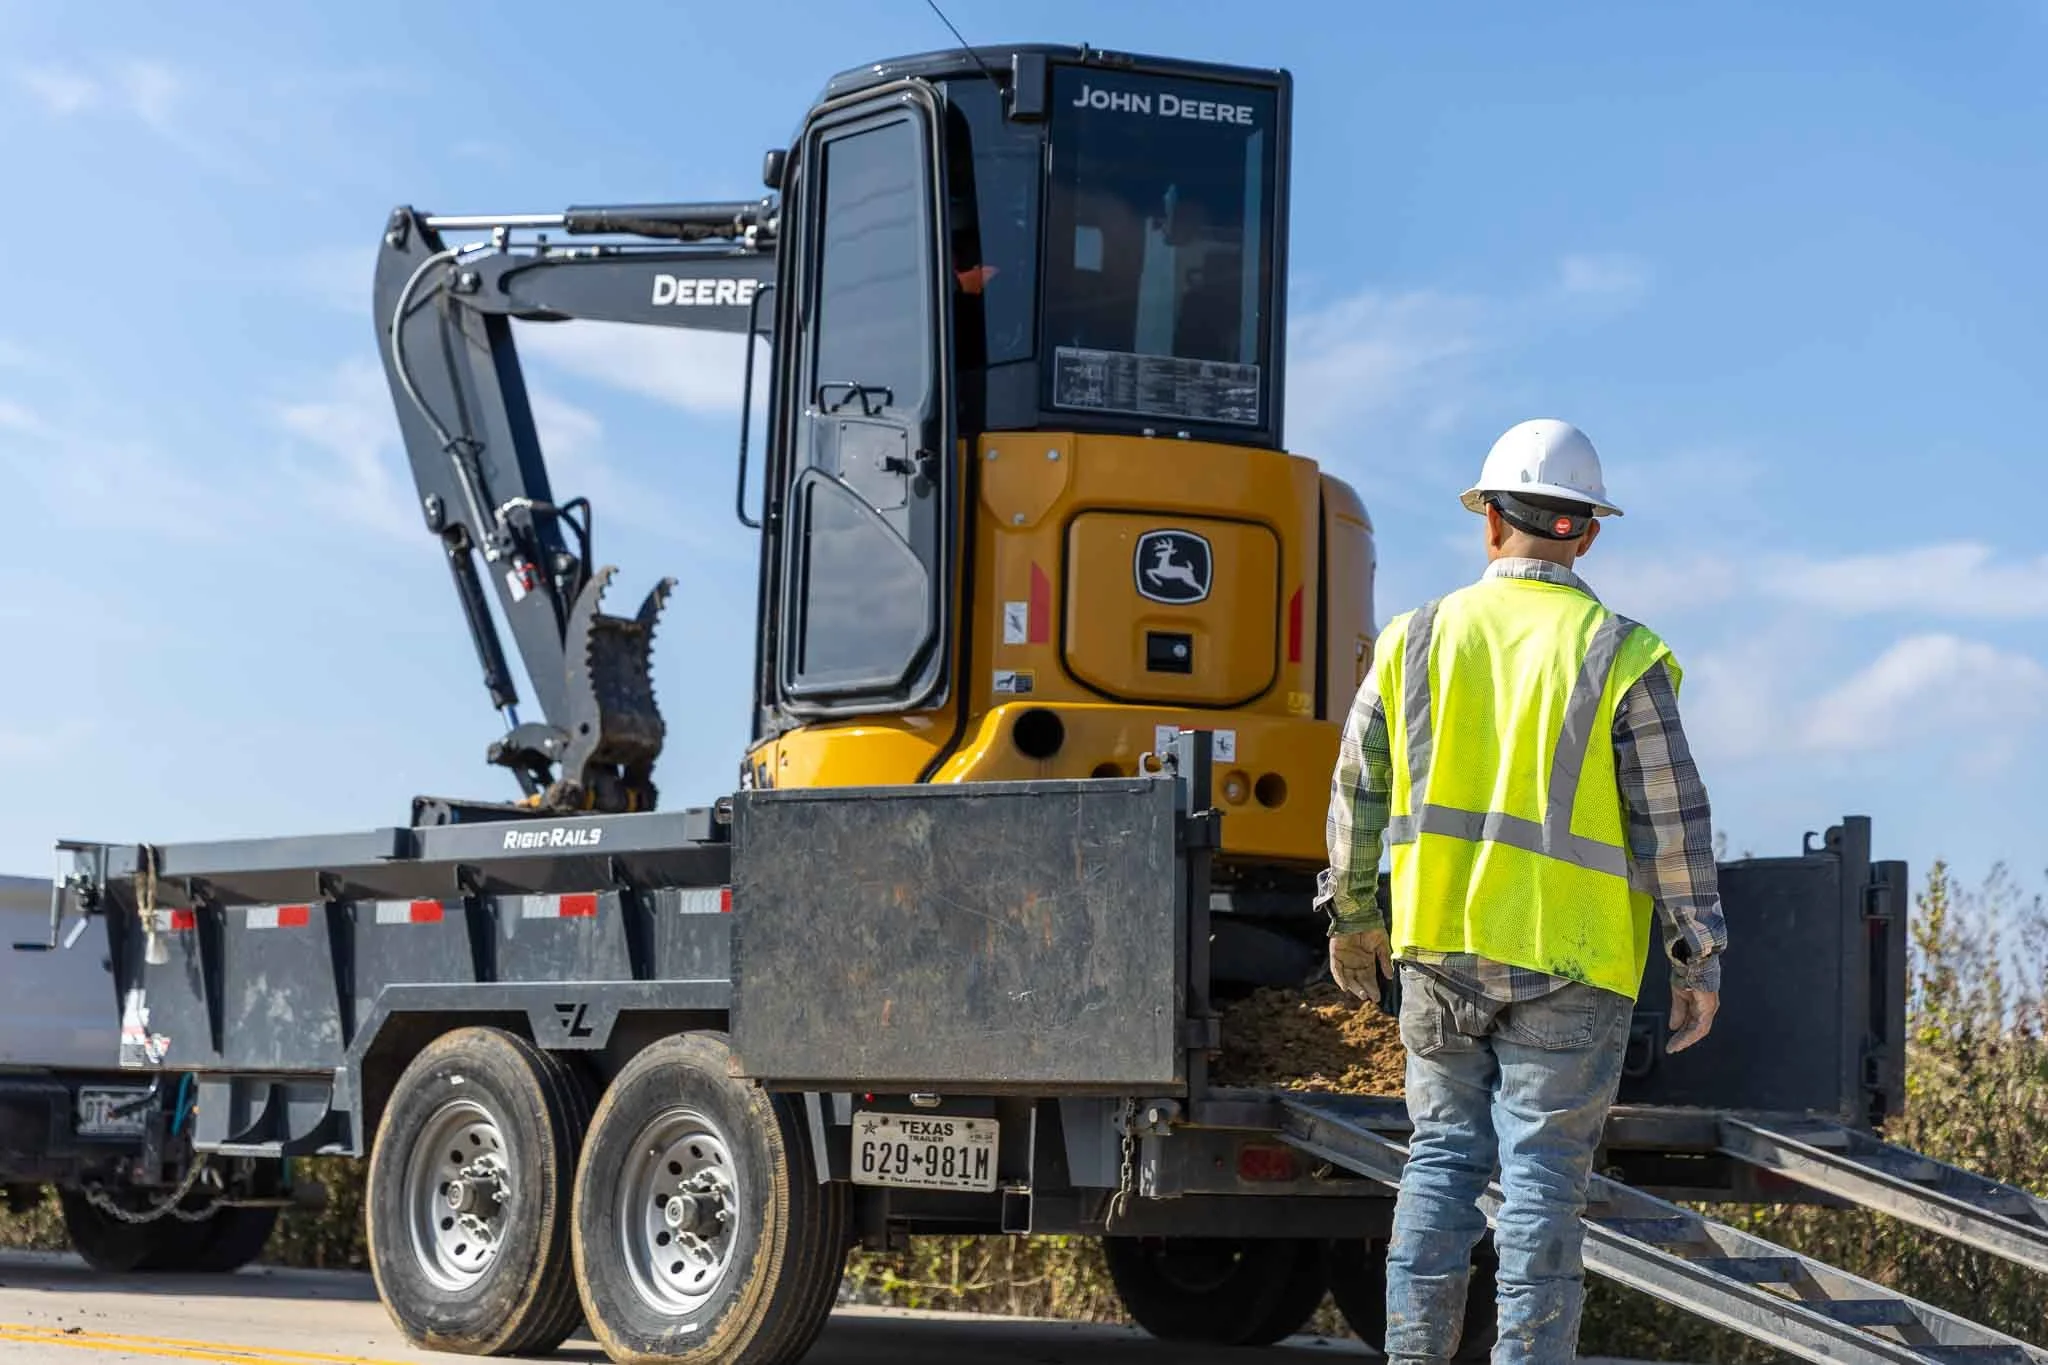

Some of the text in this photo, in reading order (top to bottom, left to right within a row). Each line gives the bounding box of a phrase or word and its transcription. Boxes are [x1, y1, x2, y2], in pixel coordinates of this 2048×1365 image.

[1072, 85, 1254, 126] JOHN DEERE
[652, 274, 758, 306] DEERE
[899, 1120, 954, 1137] TEXAS
[909, 1134, 944, 1143] TRAILER
